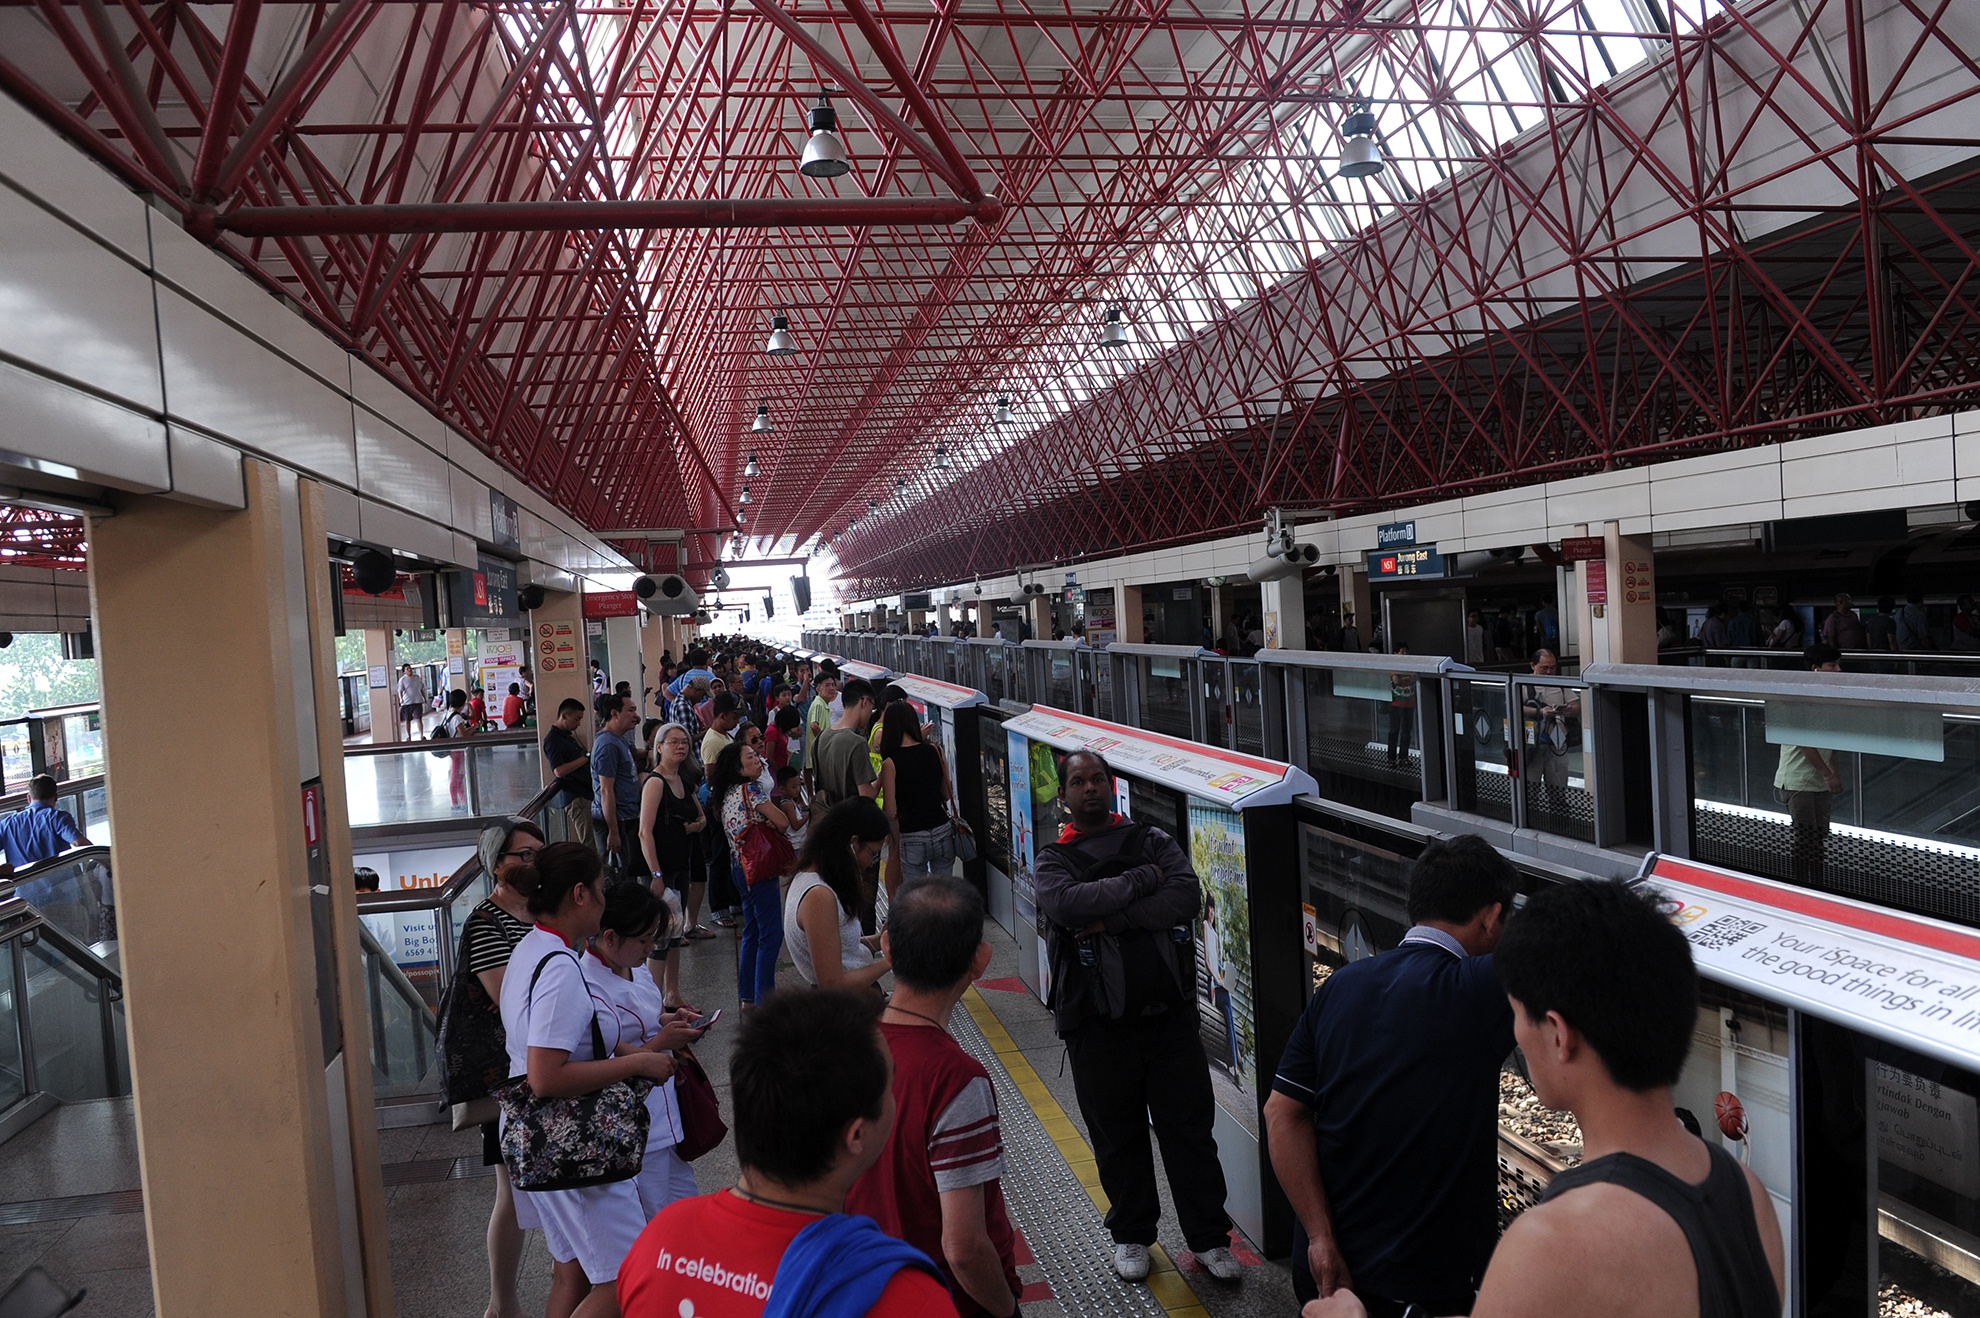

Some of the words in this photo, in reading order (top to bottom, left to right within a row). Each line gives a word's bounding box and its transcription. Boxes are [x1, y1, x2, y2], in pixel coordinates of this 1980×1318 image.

[1378, 528, 1406, 543] Platform
[1406, 525, 1413, 539] D
[1397, 553, 1415, 563] Jurong
[1416, 550, 1428, 560] East
[1384, 560, 1393, 570] NS1
[585, 593, 619, 602] Emergency
[621, 592, 635, 601] Stop
[1219, 834, 1234, 856] what
[1235, 871, 1244, 885] me
[405, 938, 420, 947] Big
[405, 948, 425, 957] 6569
[1770, 932, 1824, 955] Your
[1819, 946, 1897, 978] iSpace
[1896, 968, 1943, 990] for
[1938, 979, 1978, 1002] all
[1741, 946, 1780, 967] the
[1773, 960, 1850, 986] good
[1843, 975, 1924, 1012] things
[1919, 999, 1953, 1021] in
[1915, 1098, 1952, 1121] Dengan
[656, 1247, 672, 1271] In
